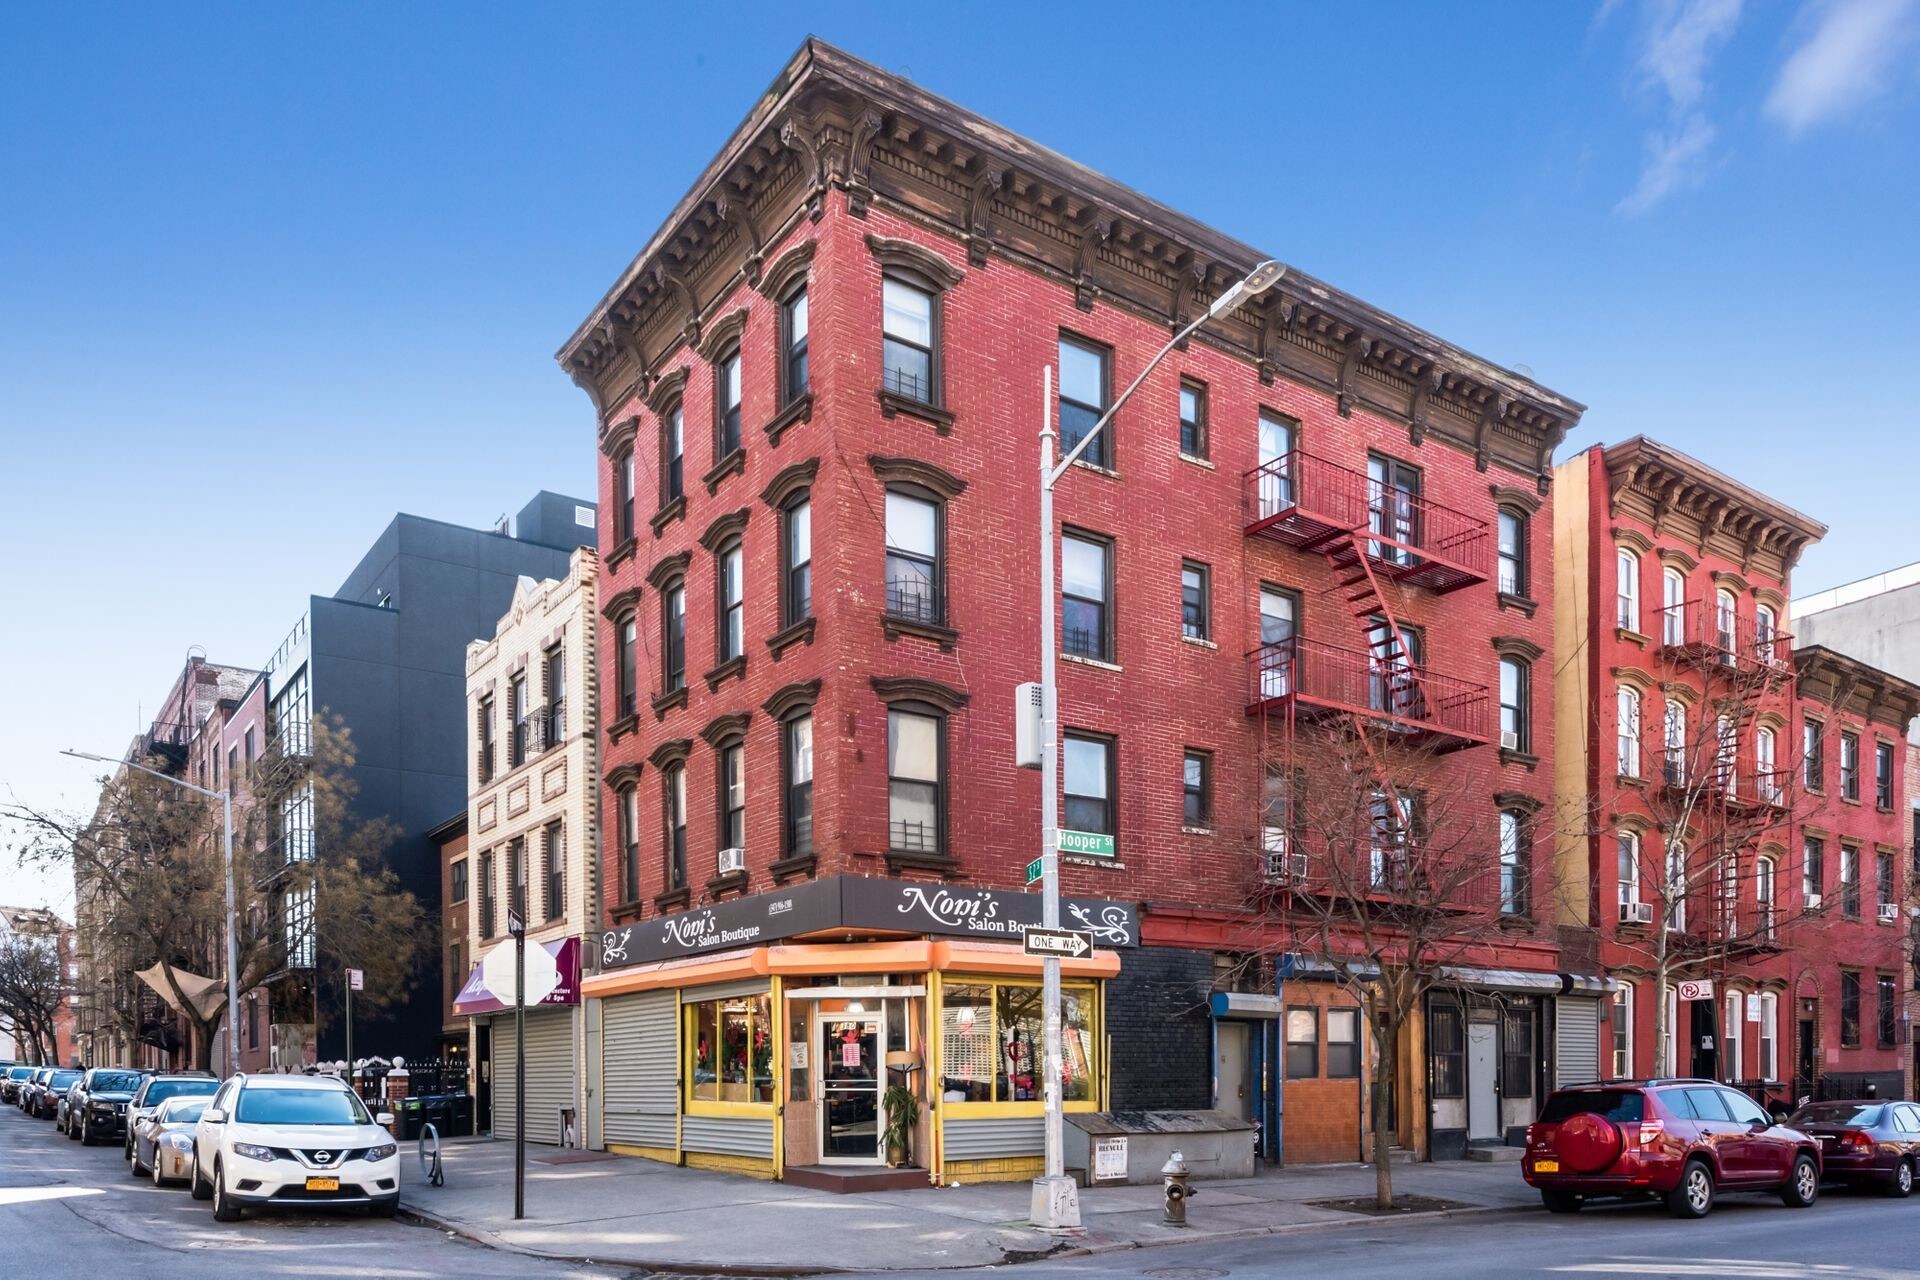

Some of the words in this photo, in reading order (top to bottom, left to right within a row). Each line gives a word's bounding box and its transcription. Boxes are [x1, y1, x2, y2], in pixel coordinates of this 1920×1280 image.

[1059, 832, 1101, 850] Hooper
[1104, 837, 1113, 846] St
[897, 887, 999, 926] Noni's
[662, 910, 716, 947] Noni's
[968, 917, 1005, 932] Salon
[698, 934, 720, 947] Salon
[721, 926, 760, 942] Boutique
[1034, 936, 1053, 948] ONE
[1063, 939, 1082, 950] WAY
